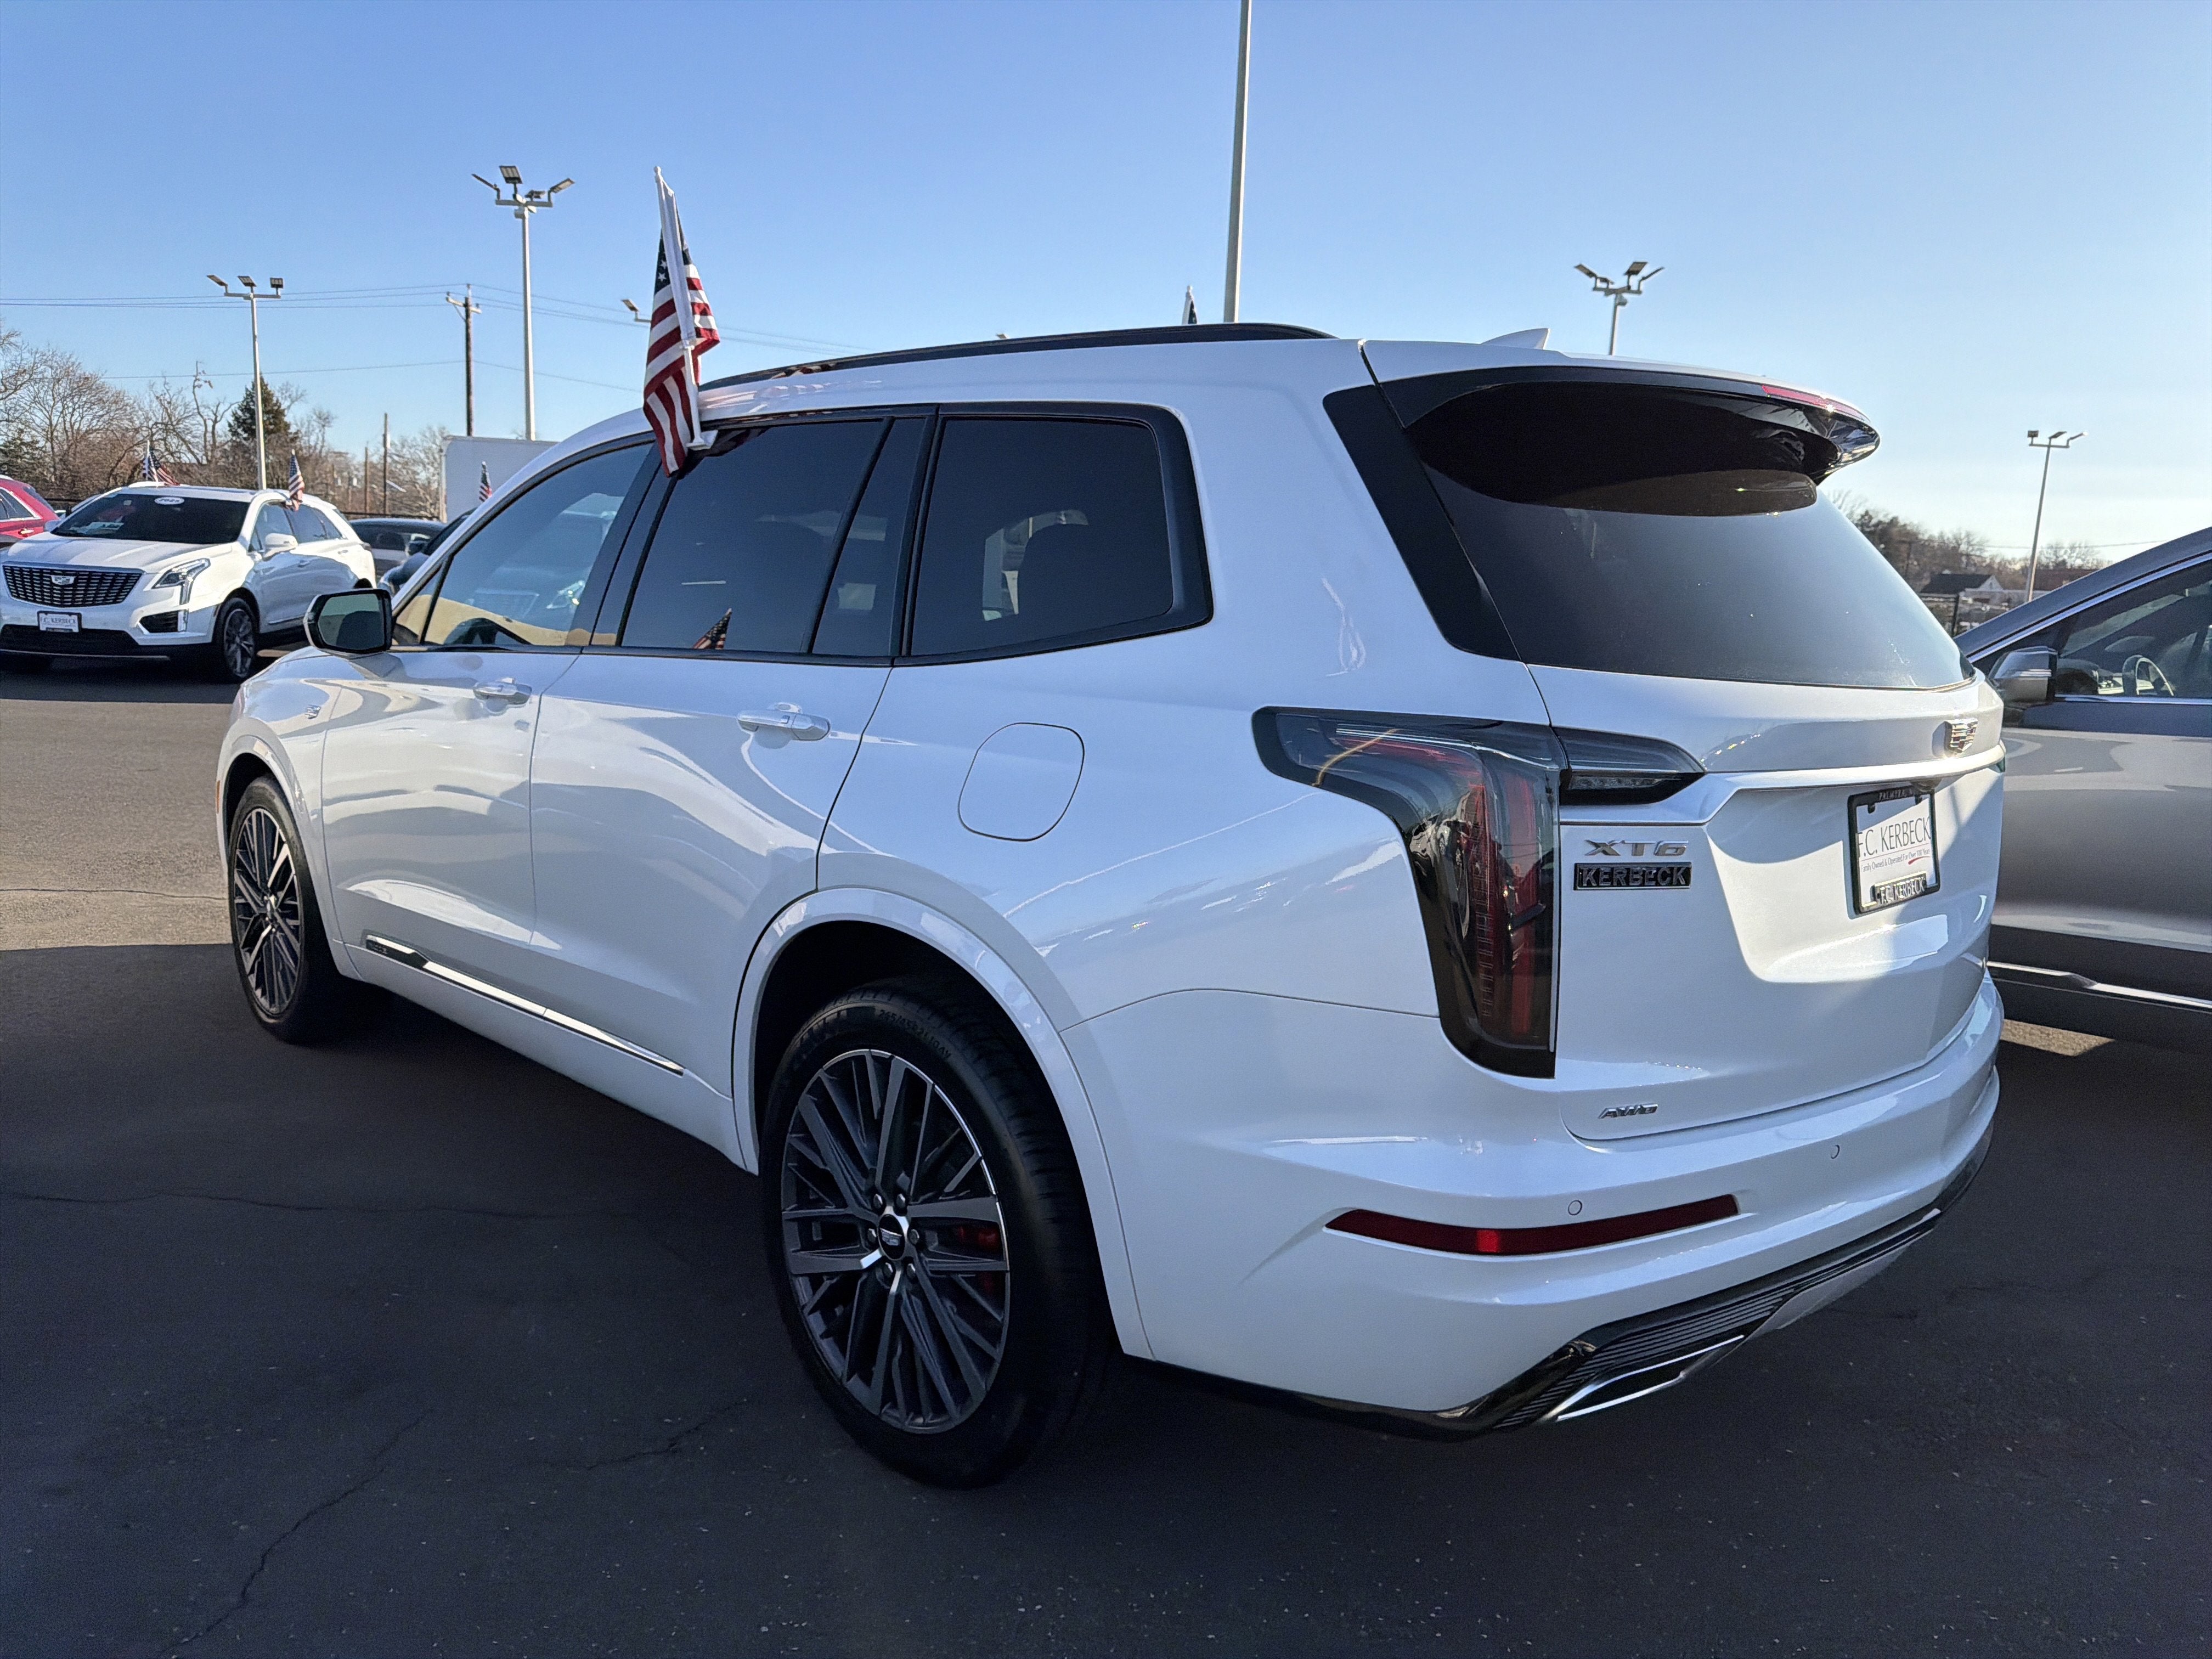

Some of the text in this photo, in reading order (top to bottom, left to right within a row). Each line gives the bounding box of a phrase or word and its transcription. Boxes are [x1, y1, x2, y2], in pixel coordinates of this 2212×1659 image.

[1857, 816, 1931, 857] F.C. KERBECK
[1584, 839, 1689, 856] XT6
[1872, 859, 1884, 870] Owned
[1888, 853, 1903, 866] Operated
[1582, 867, 1686, 887] KERBECK
[1894, 877, 1925, 900] KERBECK
[1597, 1103, 1658, 1119] AWD
